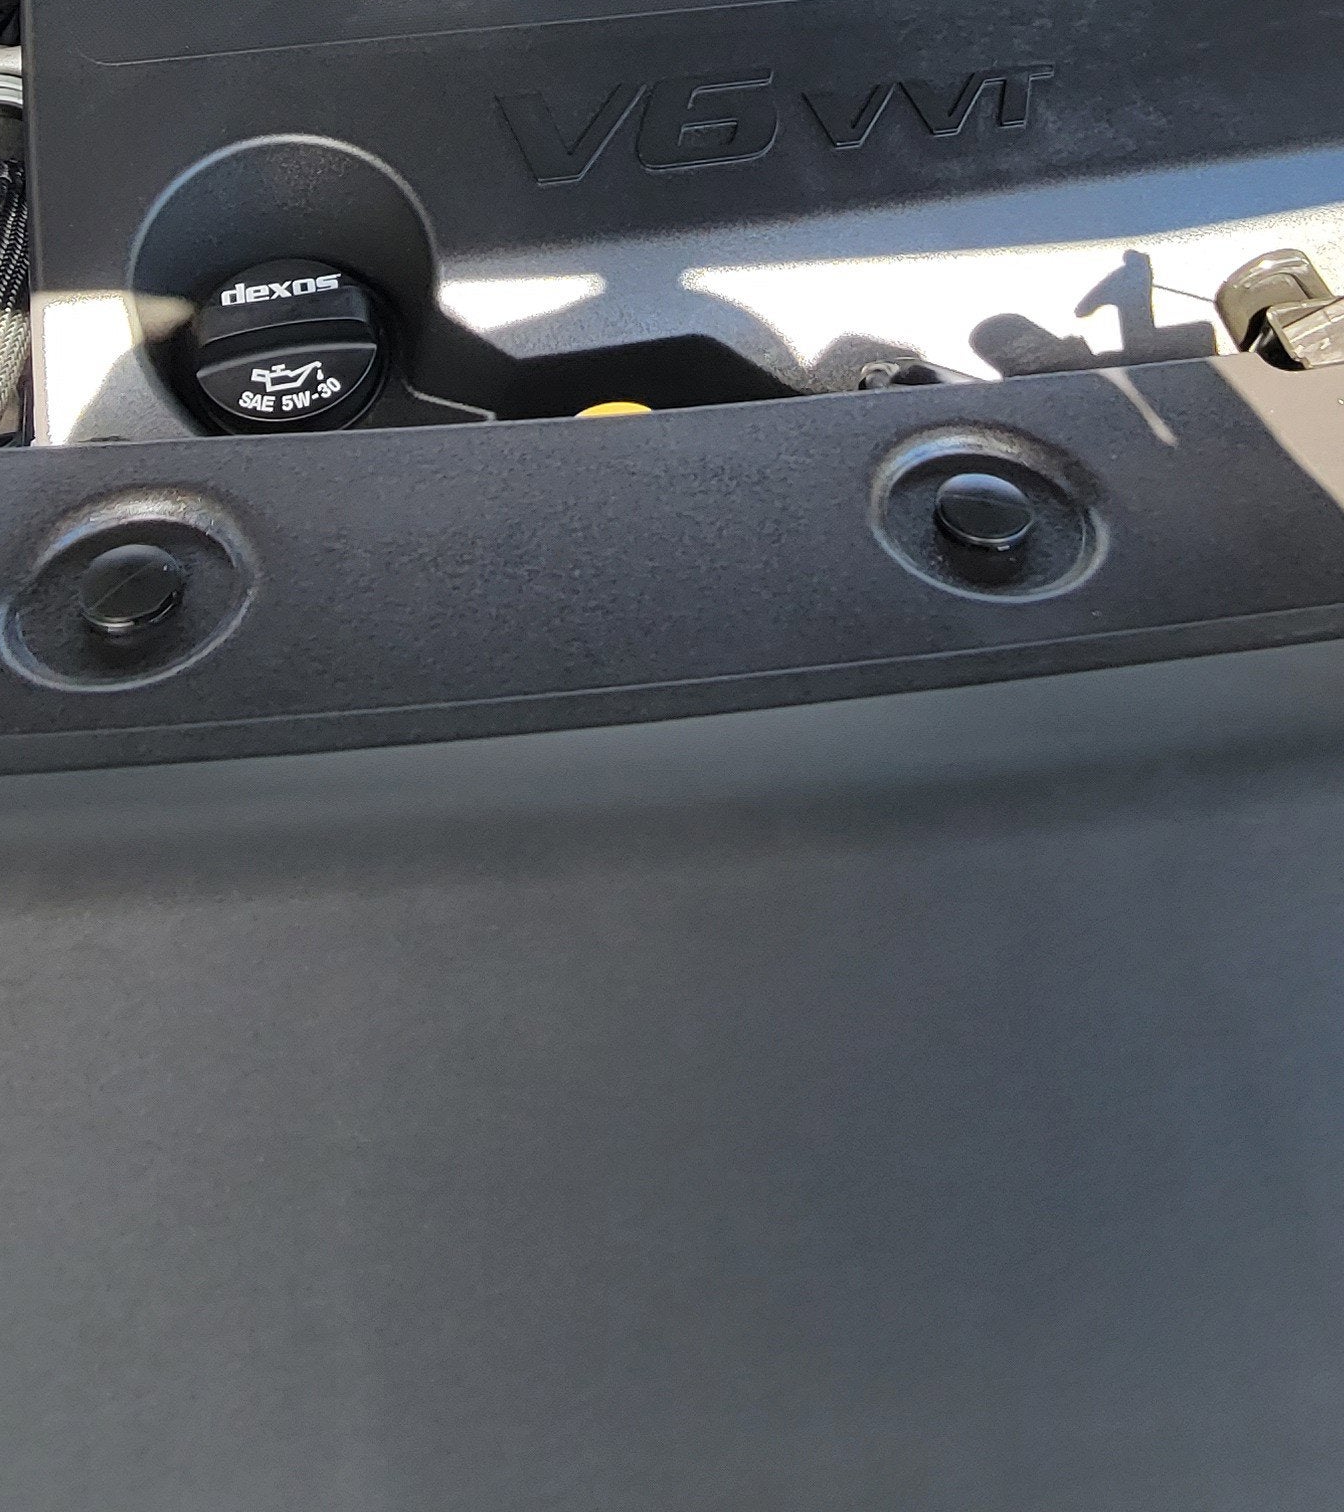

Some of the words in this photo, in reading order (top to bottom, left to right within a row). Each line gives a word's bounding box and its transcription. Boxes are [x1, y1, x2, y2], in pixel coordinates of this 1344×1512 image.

[494, 66, 780, 186] V6
[801, 64, 1054, 150] VVT
[220, 272, 342, 307] dexos
[238, 390, 277, 413] SAE
[280, 376, 342, 412] 5W-30
